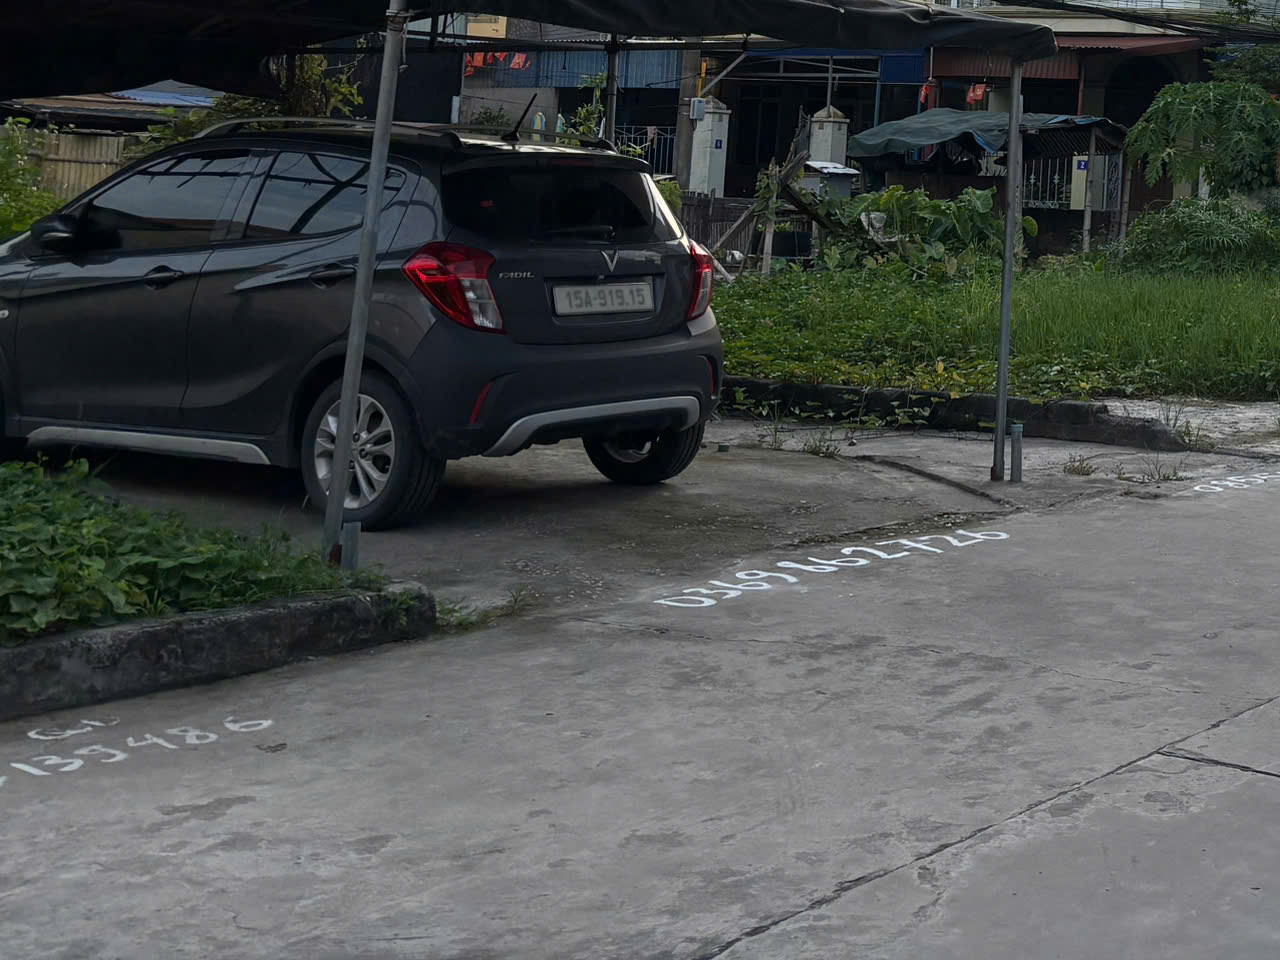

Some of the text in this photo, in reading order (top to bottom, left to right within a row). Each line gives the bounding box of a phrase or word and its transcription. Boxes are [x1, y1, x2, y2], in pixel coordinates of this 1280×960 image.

[565, 288, 646, 309] 15A-919.15
[653, 529, 1010, 608] 0369862726
[0, 715, 274, 786] 139486
